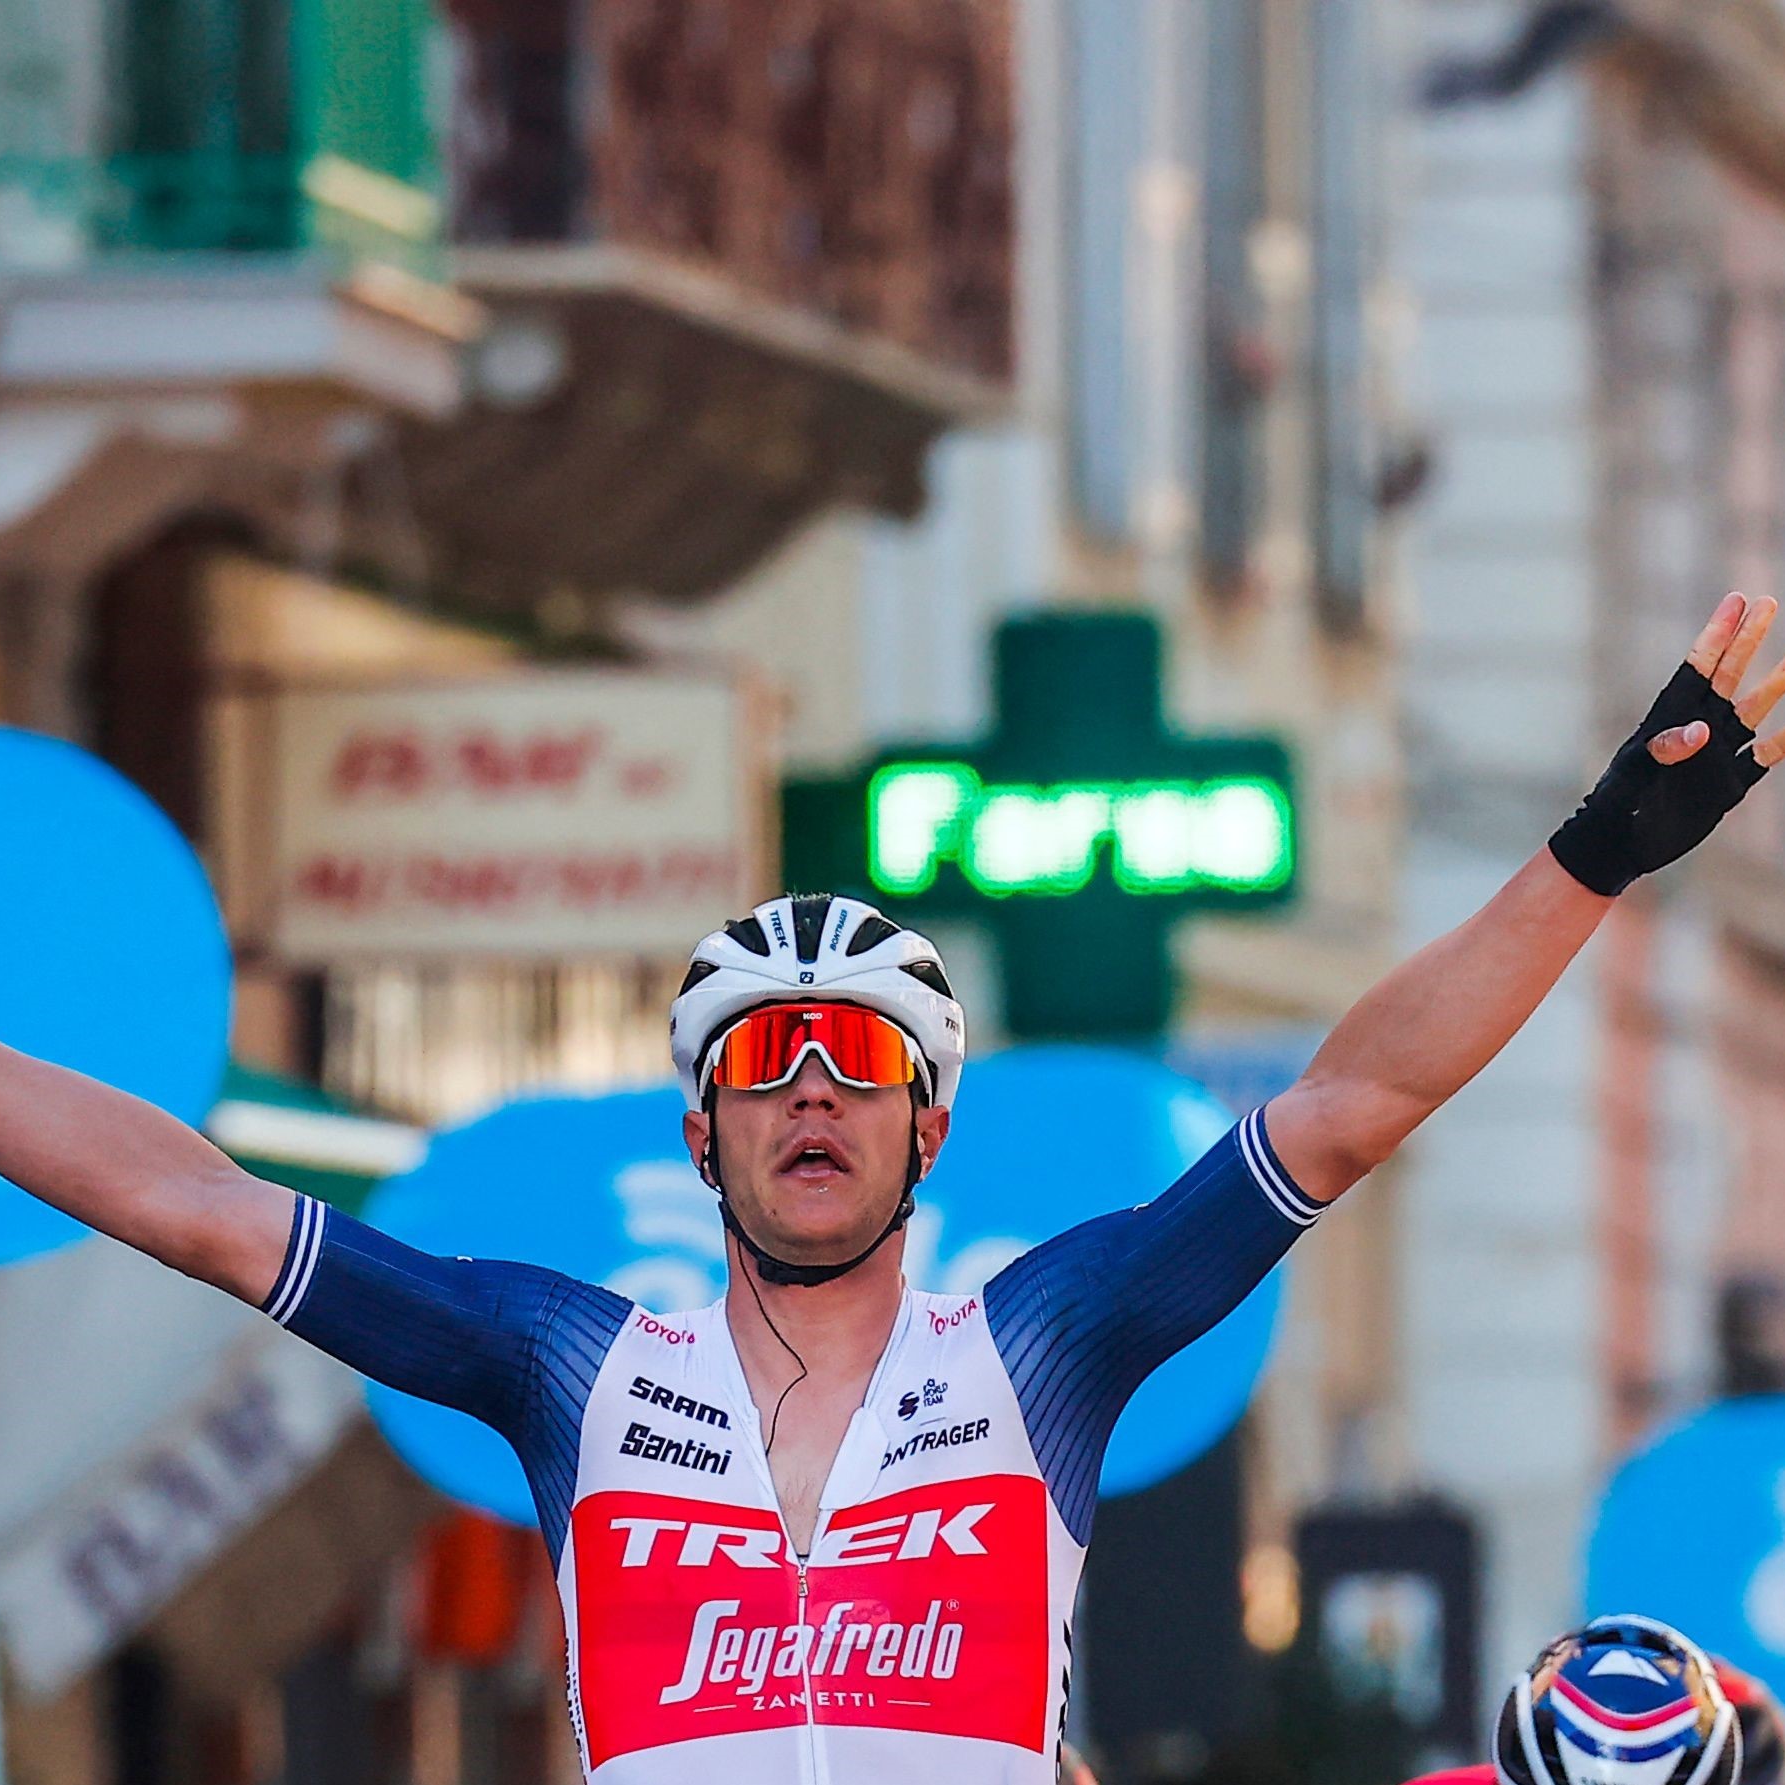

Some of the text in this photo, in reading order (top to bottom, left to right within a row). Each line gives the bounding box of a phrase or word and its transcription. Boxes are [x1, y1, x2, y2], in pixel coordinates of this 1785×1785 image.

[769, 910, 789, 949] TREK
[619, 1422, 733, 1475] Santini
[880, 1418, 990, 1471] ONTRAGER
[610, 1503, 996, 1569] TREK
[752, 1691, 875, 1711] ZANETTI
